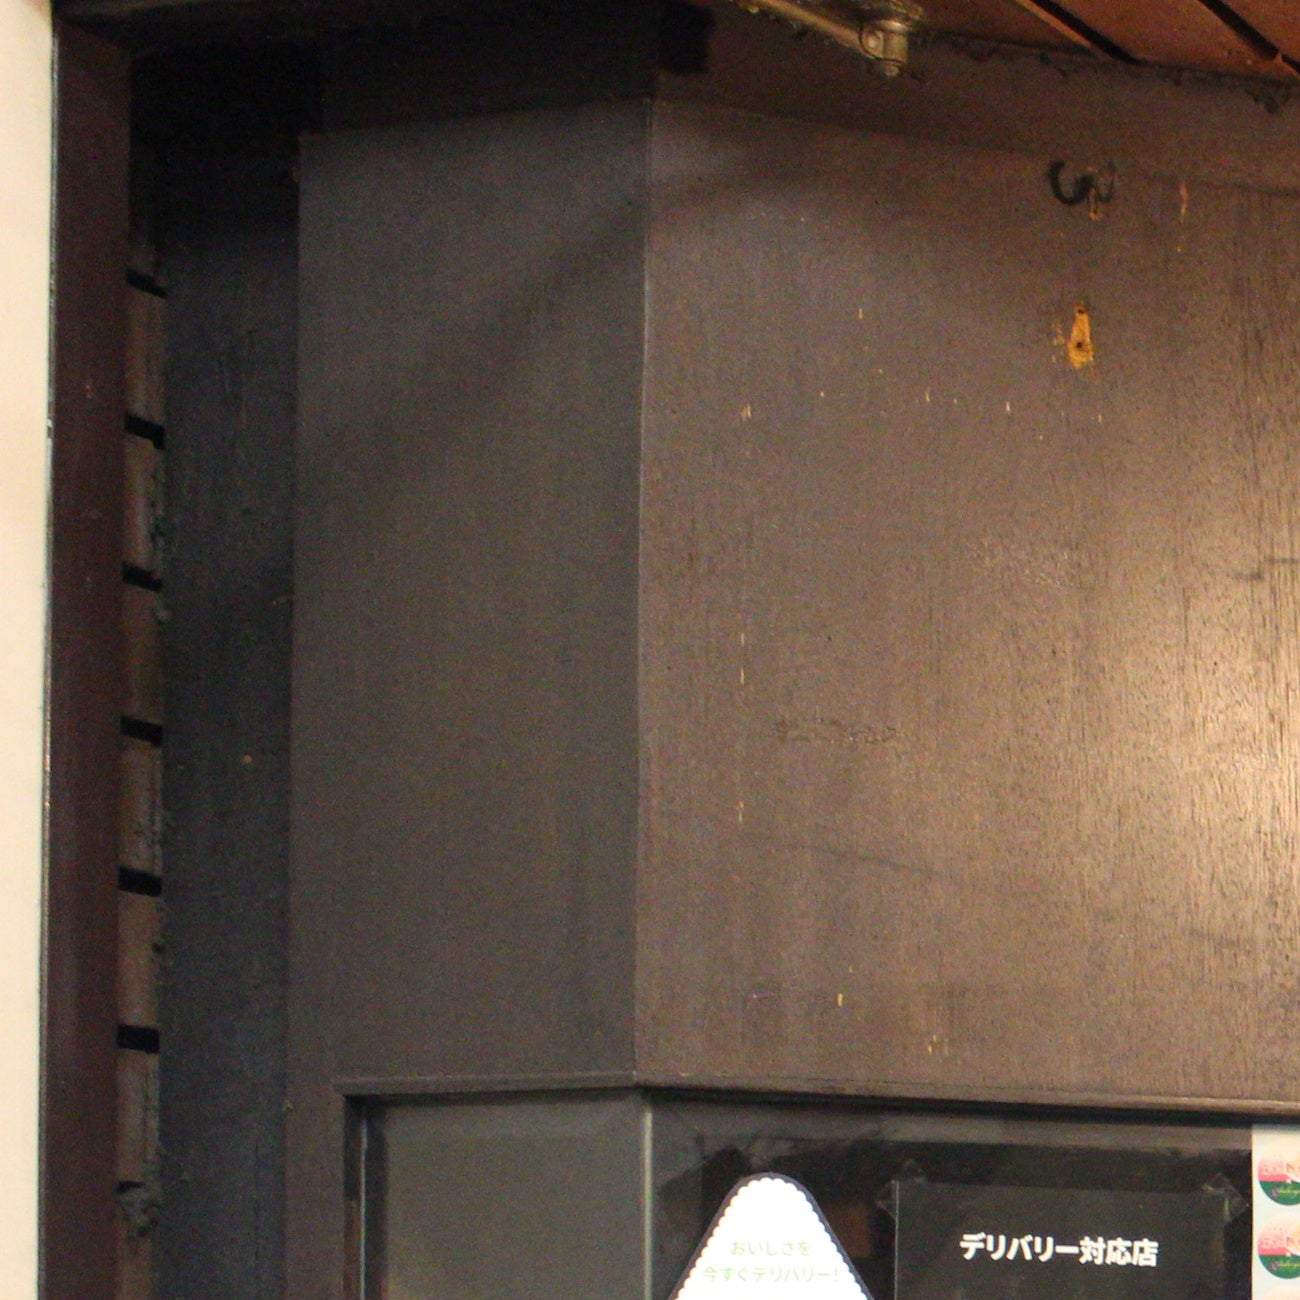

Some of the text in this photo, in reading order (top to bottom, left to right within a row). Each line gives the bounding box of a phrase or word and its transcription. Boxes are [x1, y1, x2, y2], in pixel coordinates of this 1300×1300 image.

[959, 1232, 1159, 1267] デリバリー対応店
